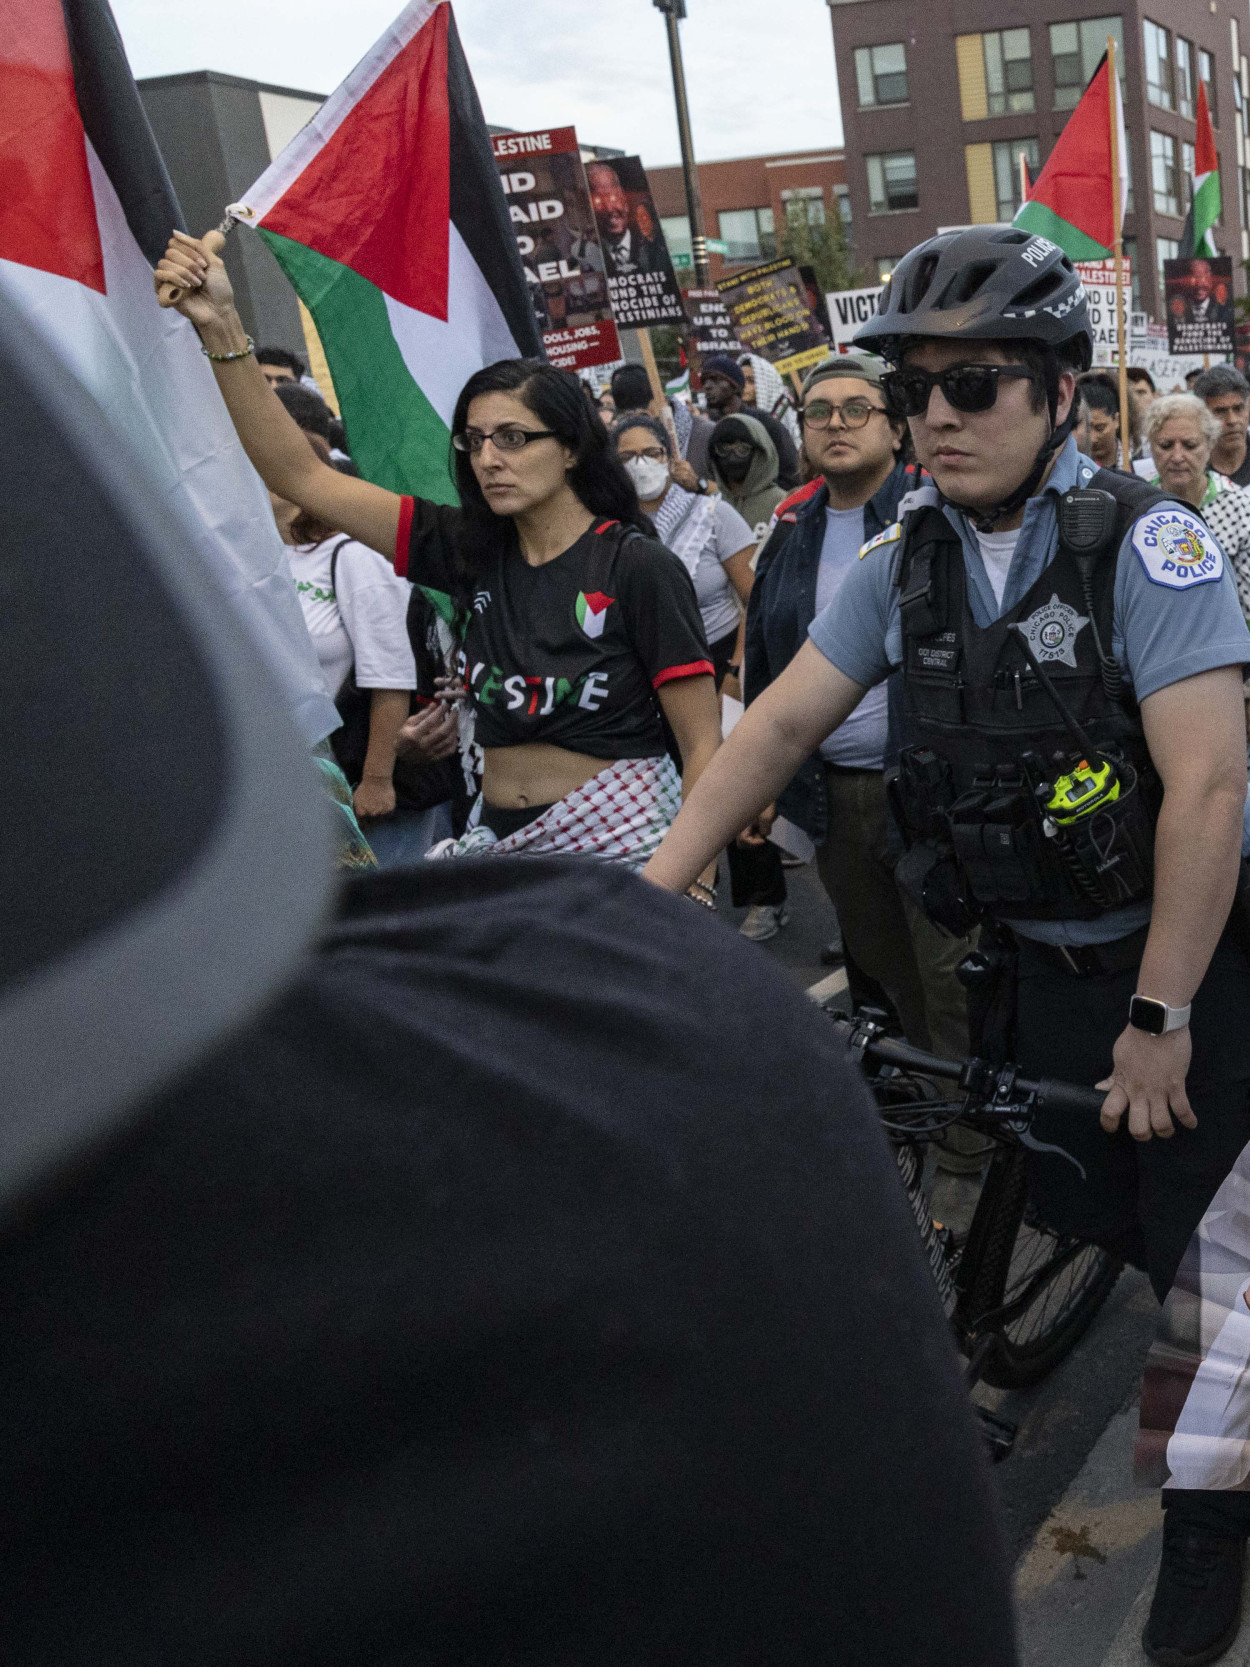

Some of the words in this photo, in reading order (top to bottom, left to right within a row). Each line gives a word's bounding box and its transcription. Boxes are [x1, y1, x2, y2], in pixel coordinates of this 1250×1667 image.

[493, 133, 552, 156] LESTINE
[1021, 237, 1057, 268] POLICE
[608, 270, 667, 289] MOCRATS
[642, 283, 664, 295] THE
[611, 294, 660, 312] NOCIDE
[662, 293, 677, 306] OF
[733, 289, 788, 315] DEMOCRATS
[835, 291, 881, 325] VICT
[614, 305, 683, 324] ESTINIANS
[715, 315, 731, 326] AI
[709, 328, 729, 339] TO
[1176, 322, 1228, 331] DEMOCRATS
[1144, 514, 1206, 547] CHICAGO
[1161, 550, 1216, 579] POLICE
[1029, 611, 1056, 641] CHICAGO
[1058, 612, 1074, 638] POLICE
[1075, 793, 1104, 813] MOTOROLA
